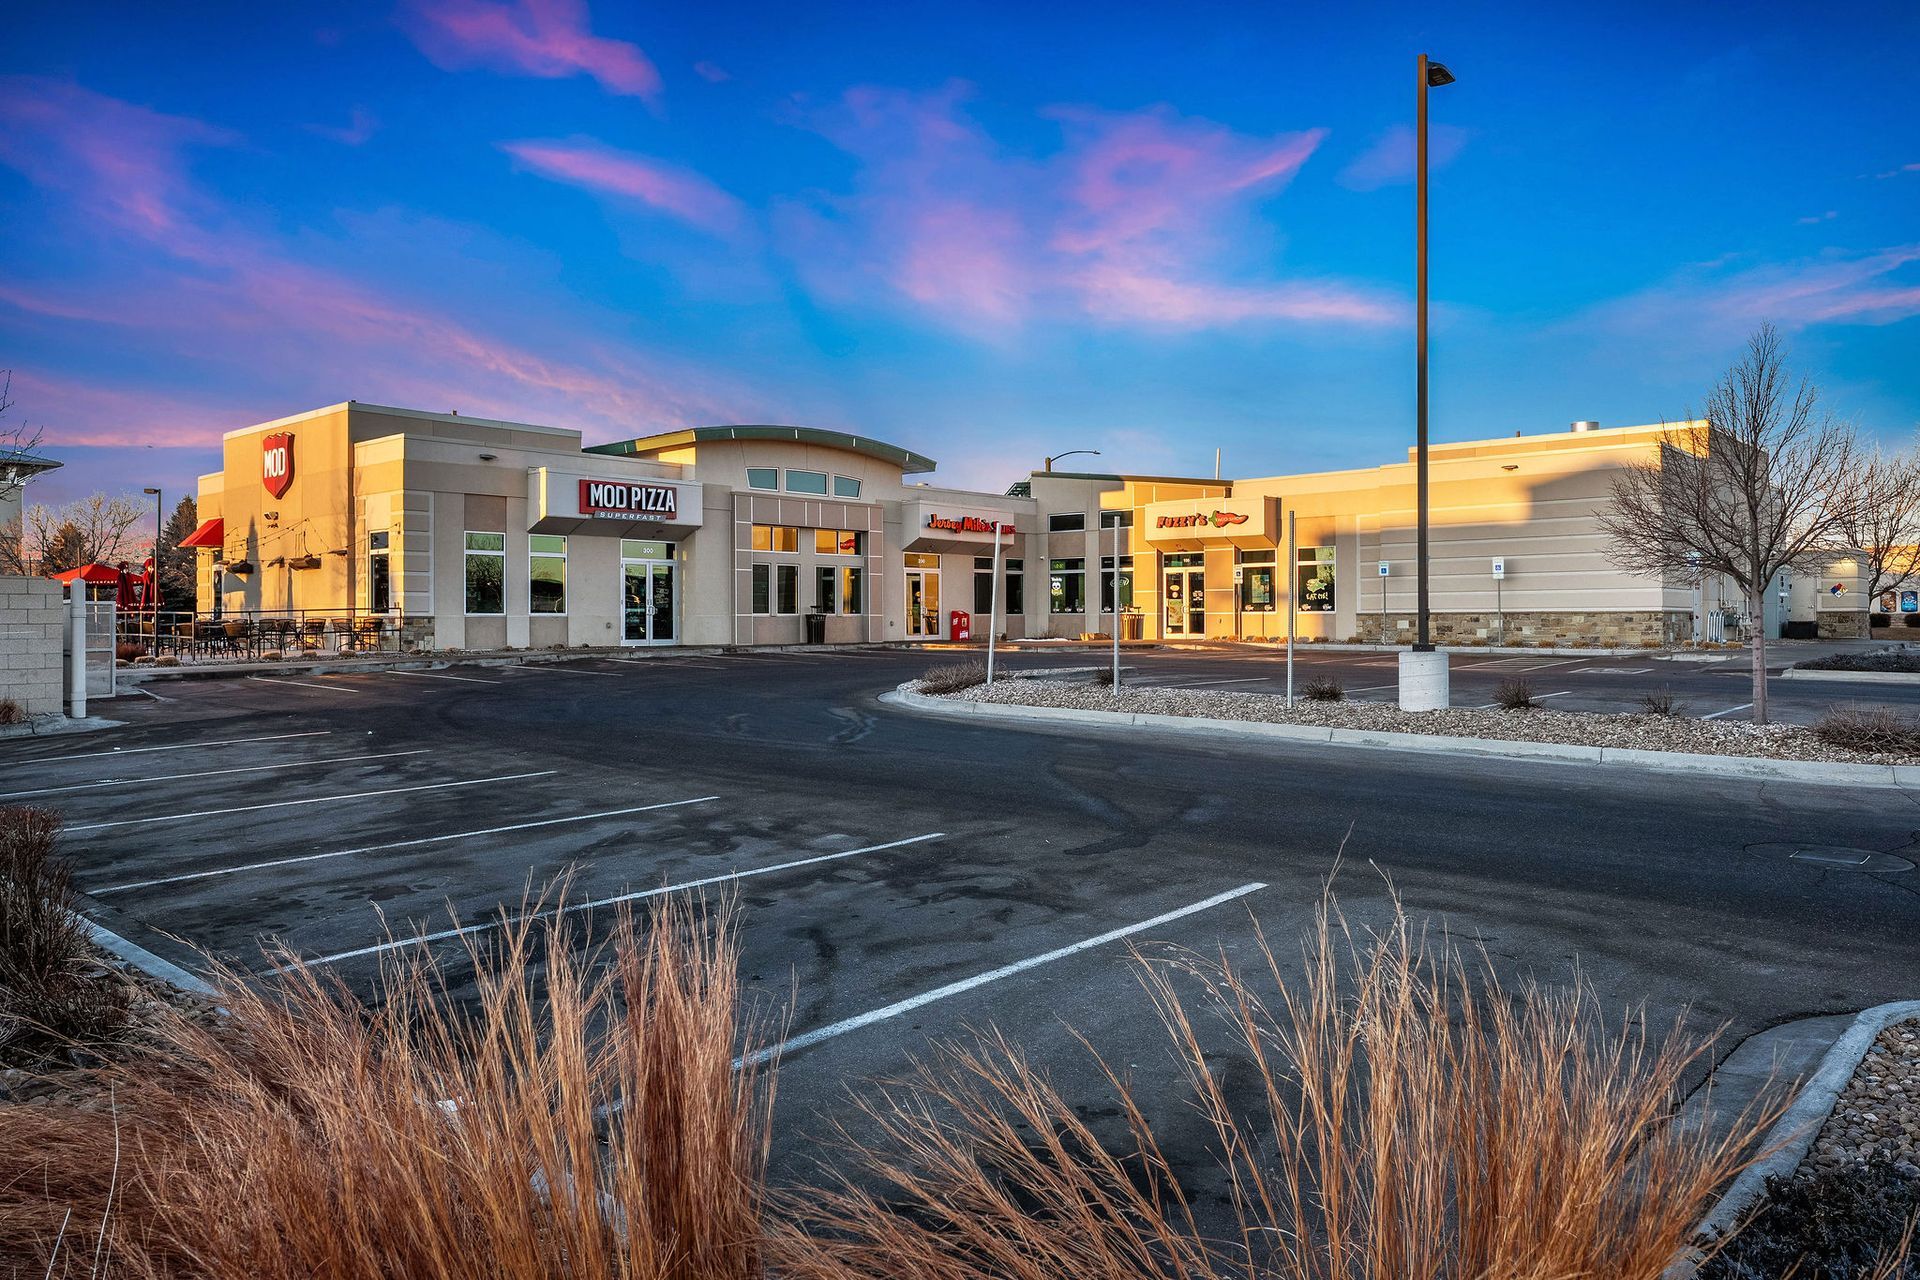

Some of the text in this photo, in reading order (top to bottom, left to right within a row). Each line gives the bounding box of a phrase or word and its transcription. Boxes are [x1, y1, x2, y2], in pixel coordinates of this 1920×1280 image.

[264, 447, 286, 478] MOD
[590, 483, 676, 512] MOD PIZZA
[600, 512, 662, 521] SUPERFAST
[927, 513, 963, 534] Jersey
